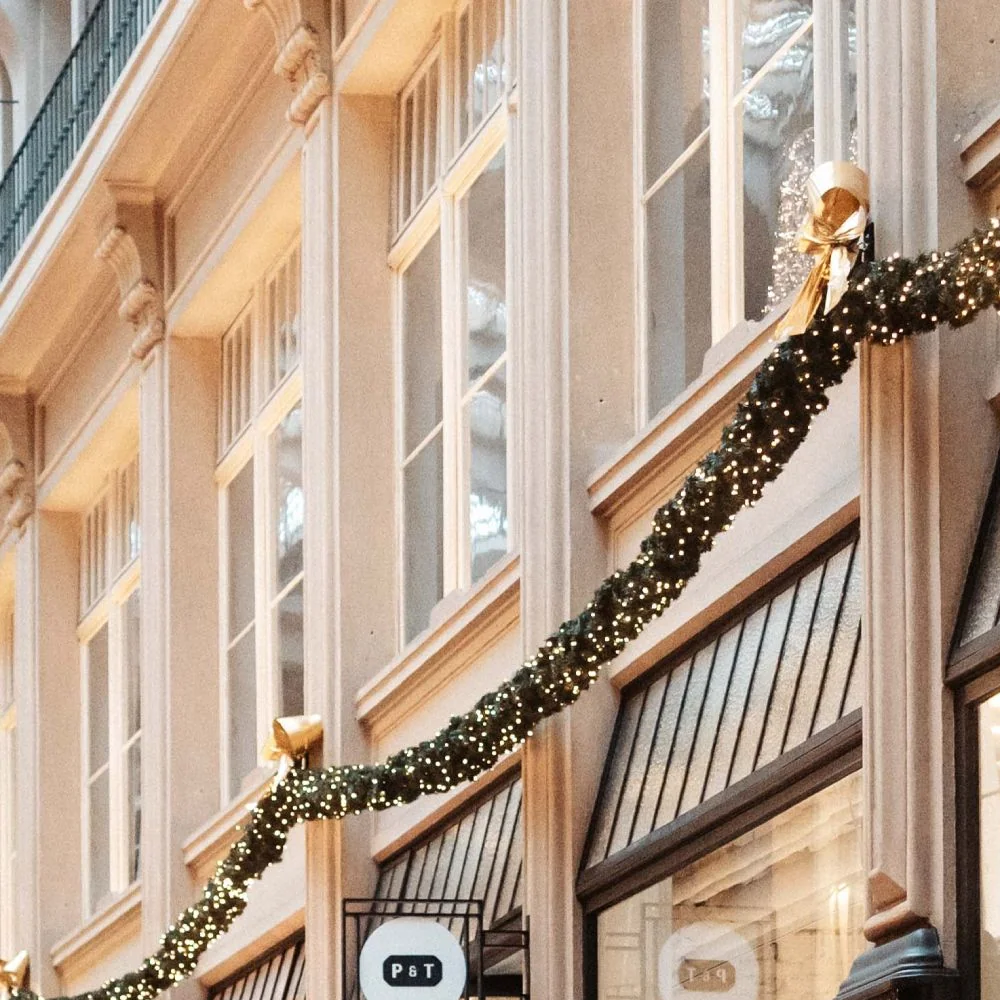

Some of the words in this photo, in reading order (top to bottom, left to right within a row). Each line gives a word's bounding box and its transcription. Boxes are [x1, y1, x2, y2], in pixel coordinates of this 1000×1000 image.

[392, 963, 403, 979] P
[408, 965, 417, 978] &
[423, 963, 434, 979] T
